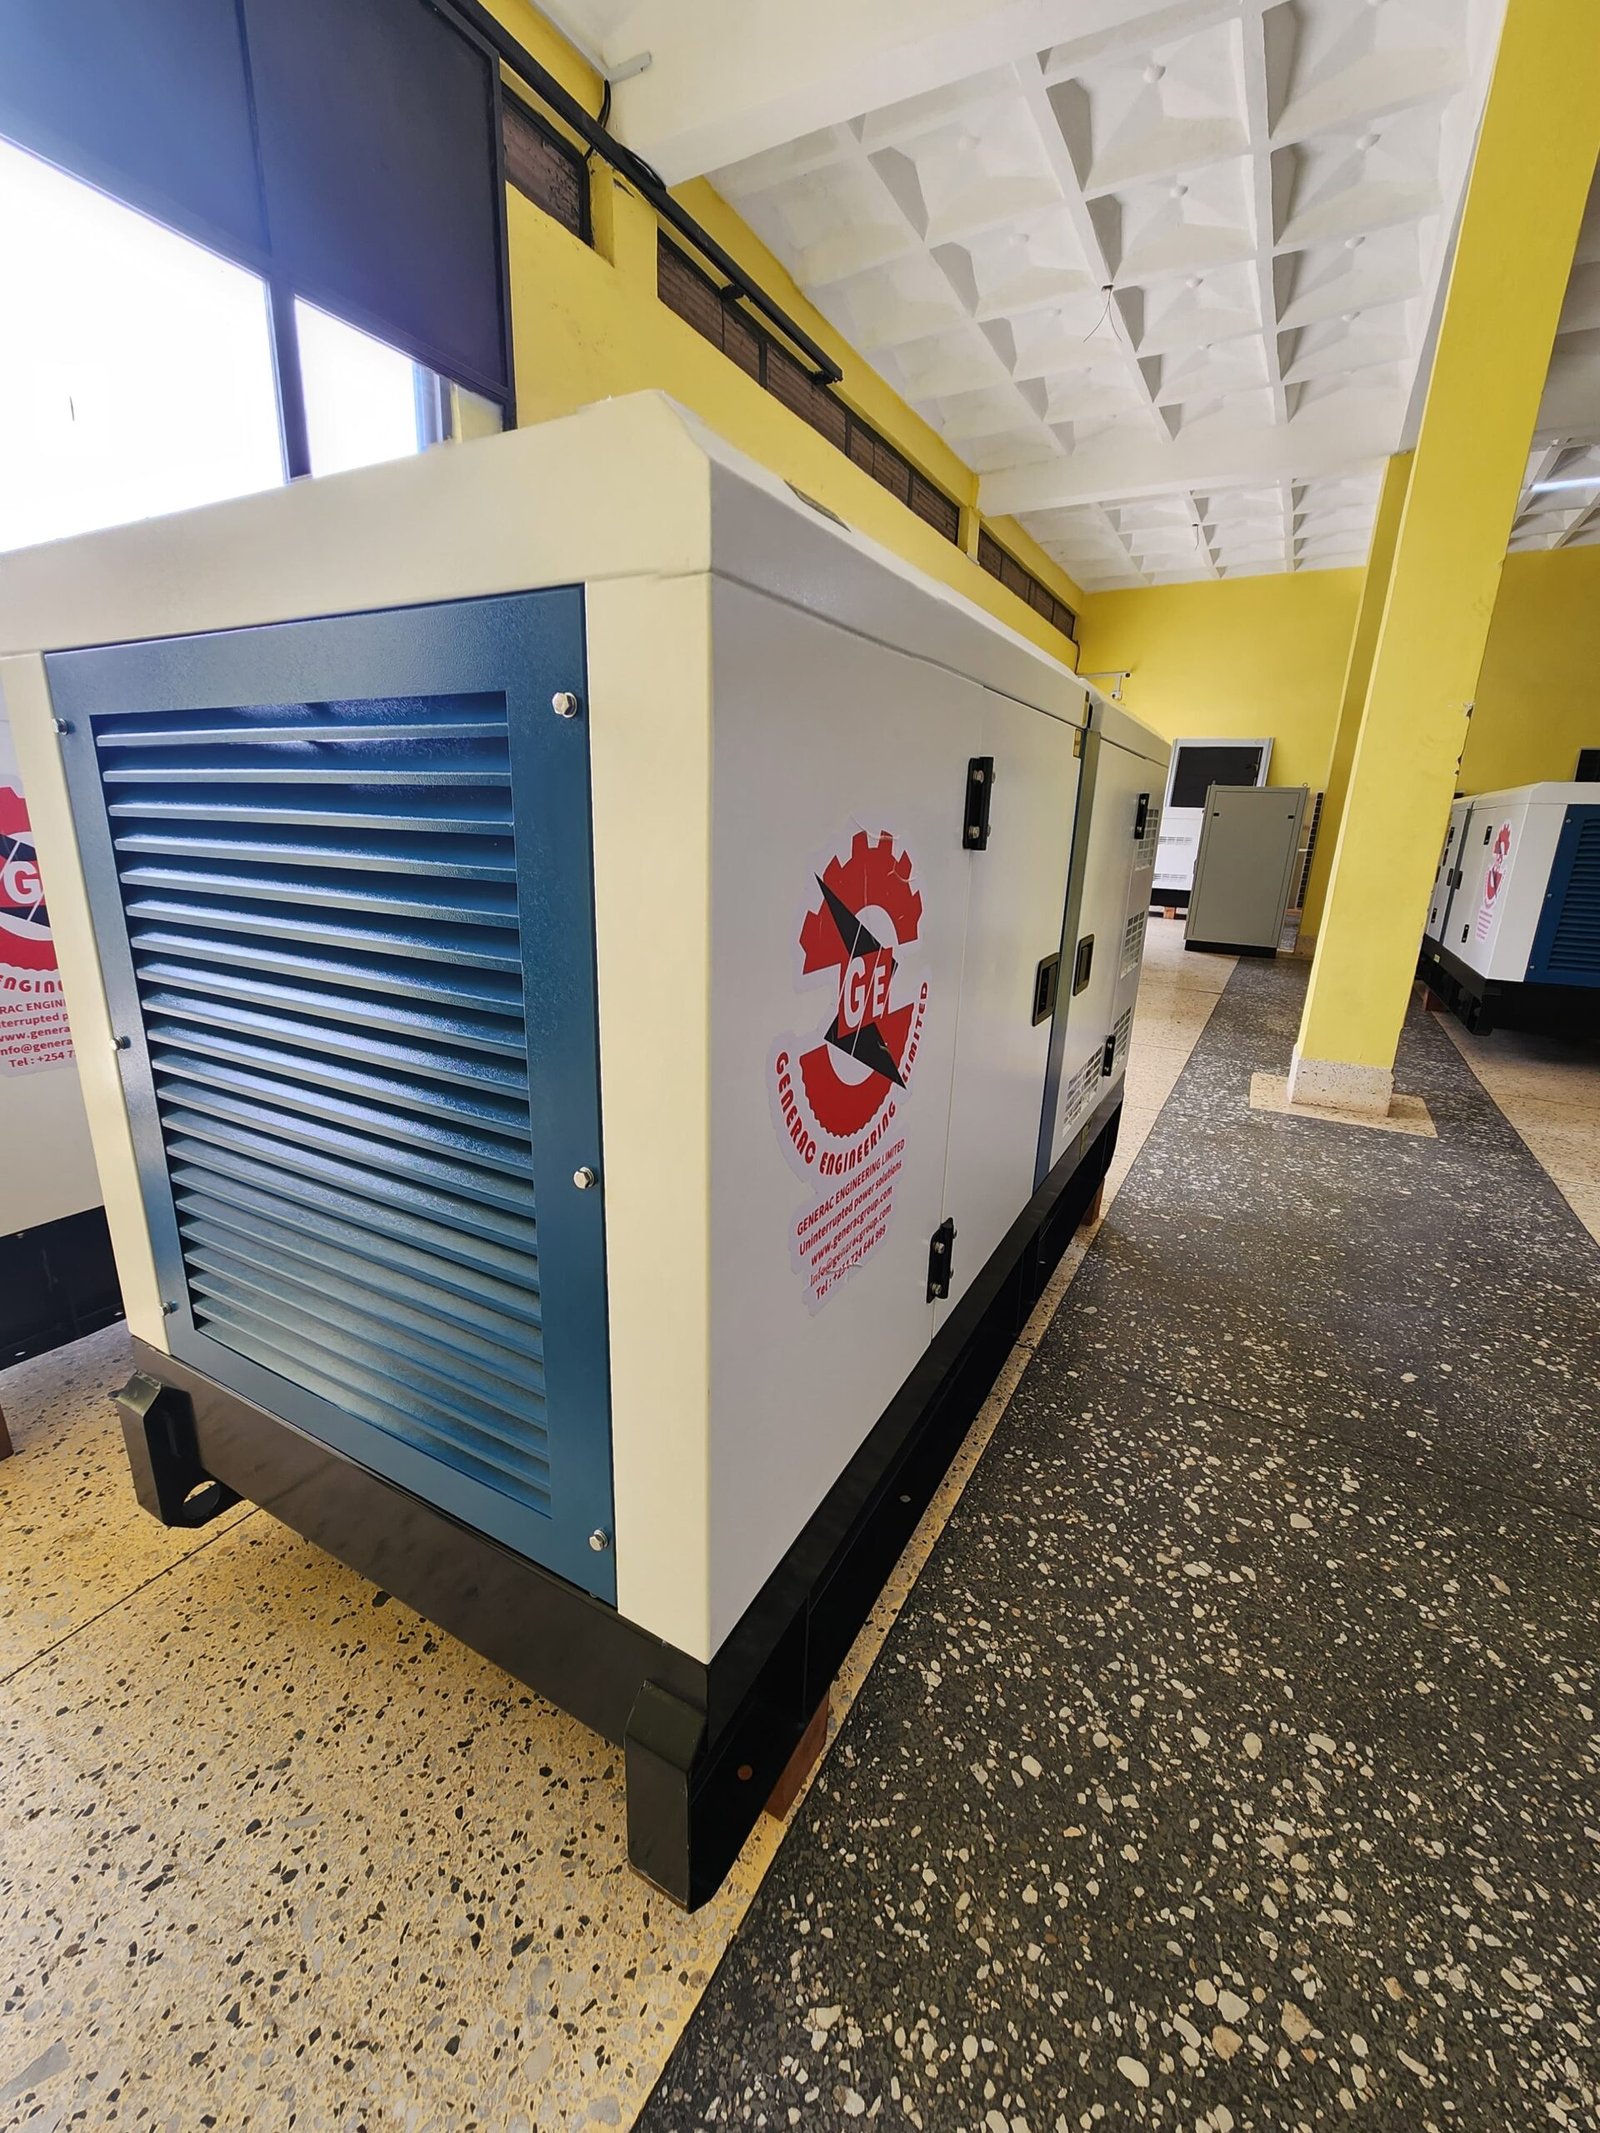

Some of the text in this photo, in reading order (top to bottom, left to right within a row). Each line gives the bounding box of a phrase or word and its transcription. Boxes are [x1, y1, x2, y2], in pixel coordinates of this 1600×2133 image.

[4, 861, 43, 904] G
[0, 1012, 59, 1028] terrupted
[843, 955, 887, 1029] GE
[9, 1057, 28, 1068] Tel
[37, 1051, 65, 1062] +254
[797, 1139, 905, 1236] GENERAC ENGINEERING LIMITED
[799, 1160, 902, 1256] Uninterrupted power solutions
[811, 1186, 893, 1266] www.generacgroup.com
[816, 1279, 828, 1299] Tel
